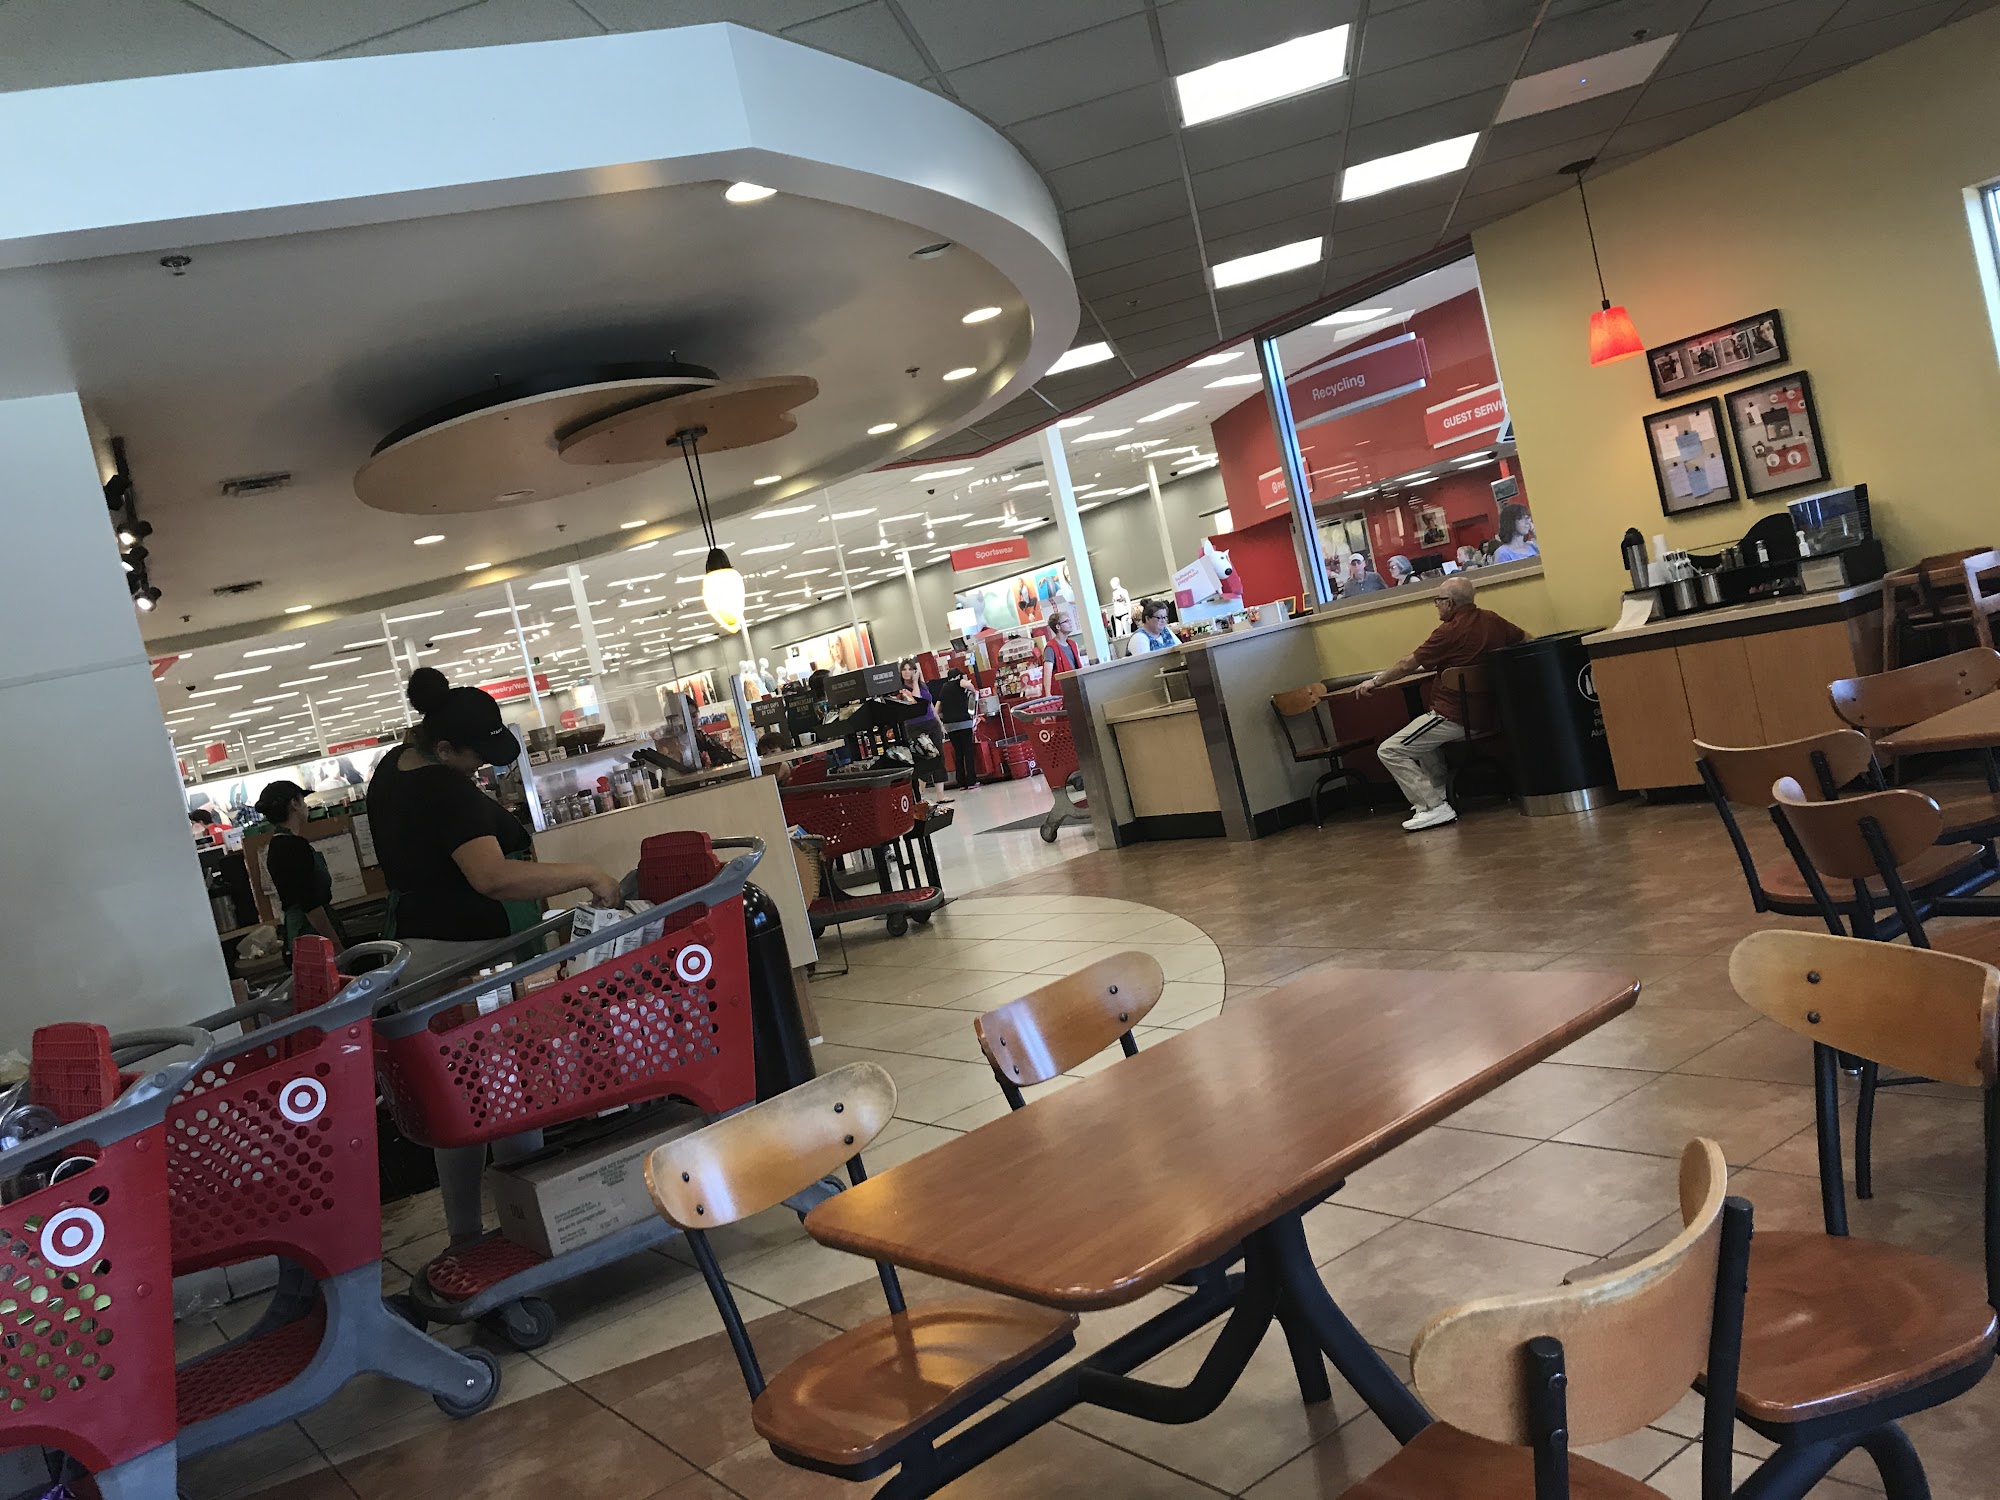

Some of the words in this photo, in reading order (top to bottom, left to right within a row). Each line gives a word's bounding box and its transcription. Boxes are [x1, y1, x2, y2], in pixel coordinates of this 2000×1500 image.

[1311, 373, 1366, 401] Recycling
[1443, 410, 1473, 429] GUEST
[975, 546, 1014, 560] Sportswear
